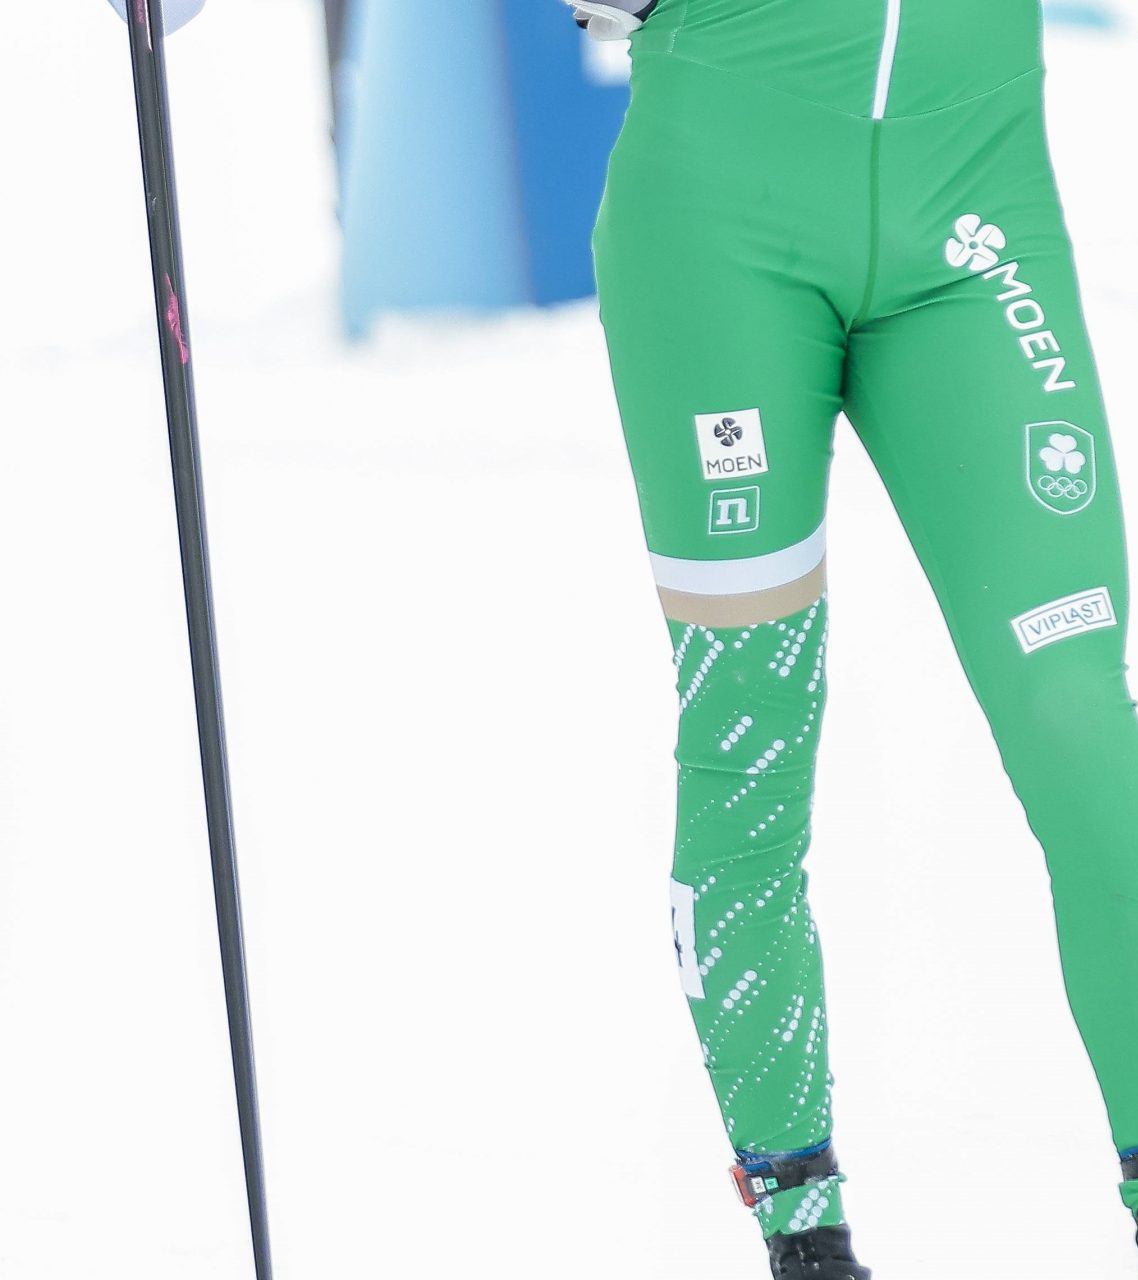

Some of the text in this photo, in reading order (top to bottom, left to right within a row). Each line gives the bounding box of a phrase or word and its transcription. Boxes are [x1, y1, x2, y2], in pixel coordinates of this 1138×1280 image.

[982, 260, 1076, 393] MOEN
[706, 453, 763, 475] MOEN
[1027, 599, 1104, 637] VIPLAST
